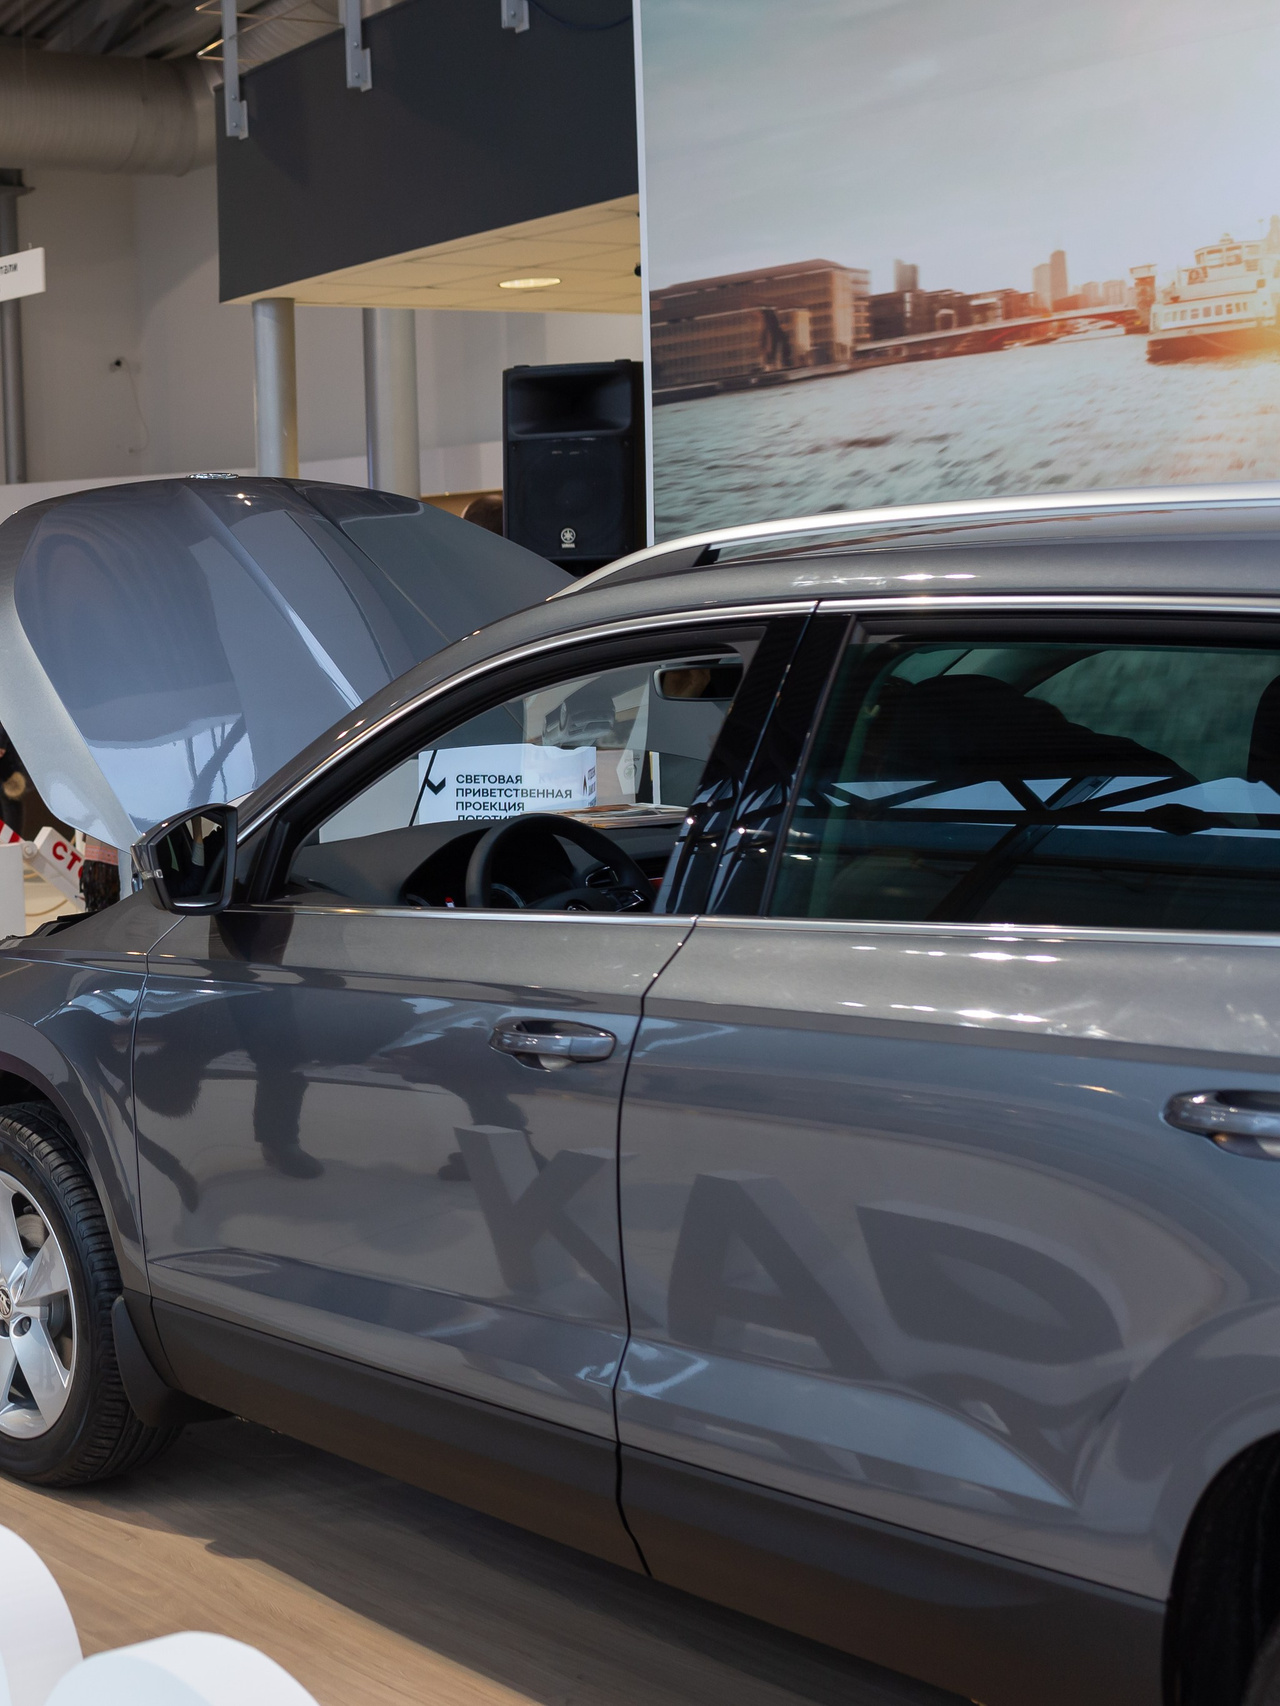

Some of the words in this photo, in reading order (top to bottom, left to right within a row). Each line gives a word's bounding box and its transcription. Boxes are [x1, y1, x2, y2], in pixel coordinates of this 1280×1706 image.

[456, 774, 522, 784] СВЕТОВАЯ
[456, 788, 572, 799] ПРИВЕТСТВЕННАЯ
[456, 801, 524, 813] ПРОЕКЦИЯ
[52, 841, 84, 880] СТ
